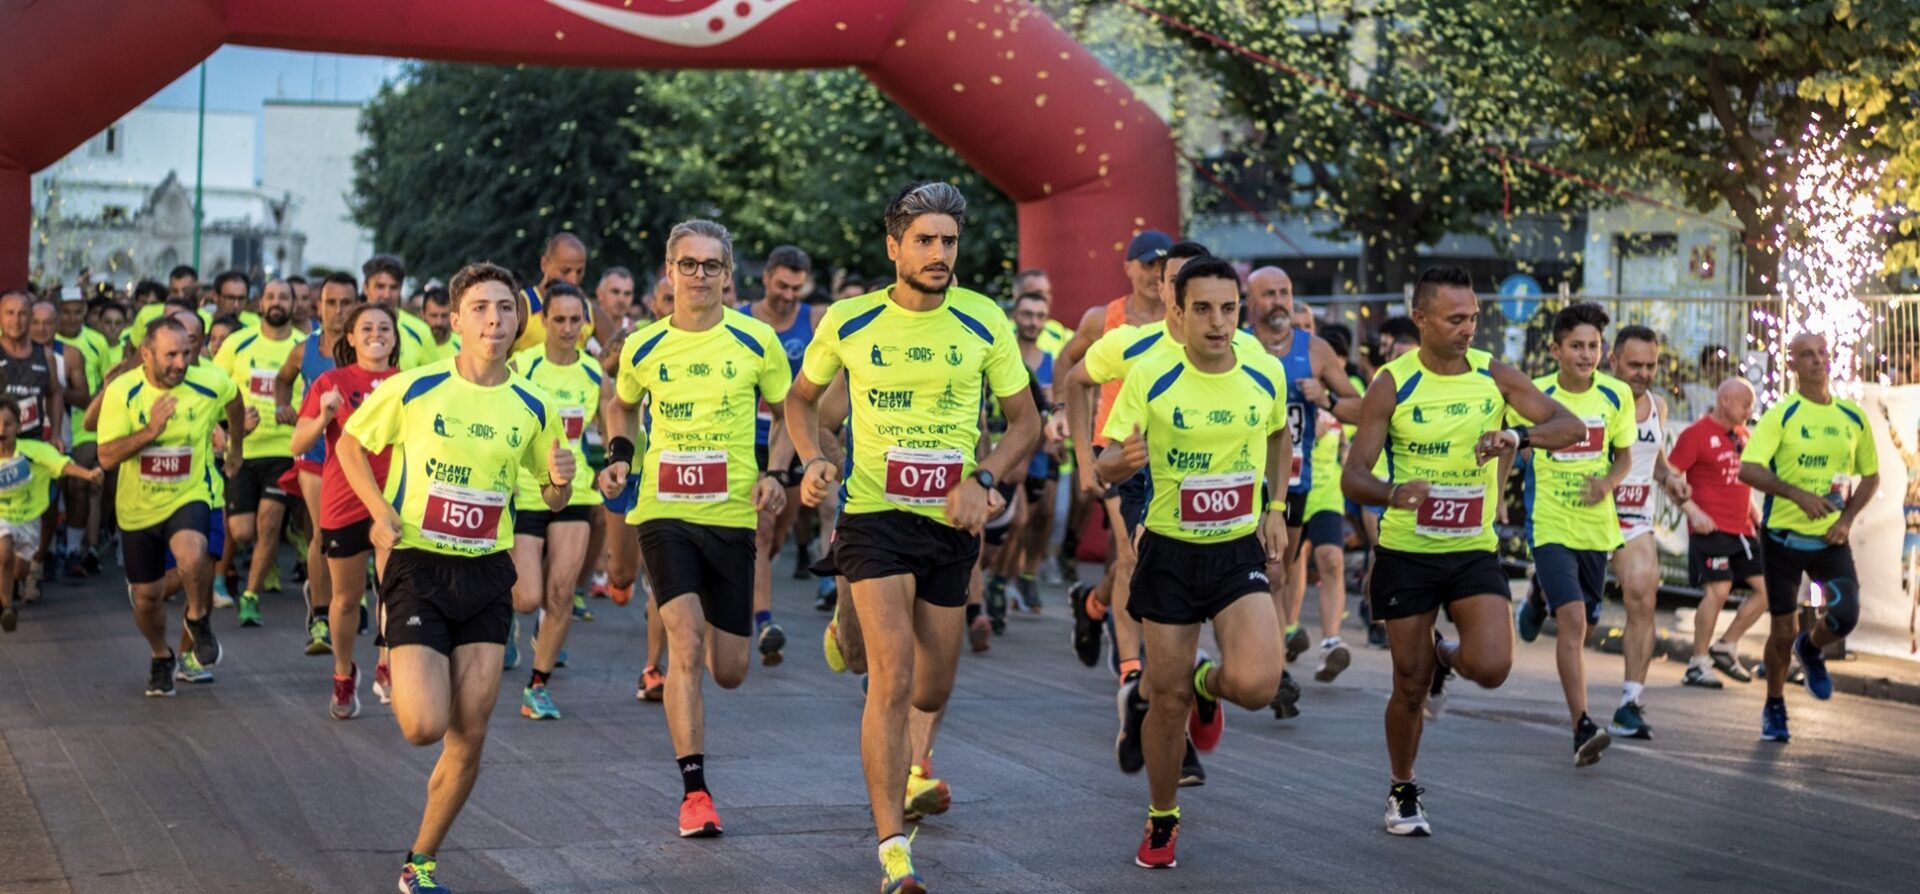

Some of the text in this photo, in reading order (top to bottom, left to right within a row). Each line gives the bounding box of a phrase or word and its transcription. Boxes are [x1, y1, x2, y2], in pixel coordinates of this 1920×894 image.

[908, 347, 933, 361] FIDAS
[879, 390, 914, 400] PLANET
[889, 399, 912, 408] GYM
[471, 423, 495, 439] FIDAS
[151, 456, 180, 473] 248
[1178, 451, 1214, 462] PLANET
[437, 462, 473, 477] PLANET
[1189, 460, 1210, 470] GYM
[447, 474, 470, 486] GYM
[675, 465, 705, 487] 161
[900, 465, 947, 492] 078
[1192, 489, 1240, 514] 080
[1616, 485, 1644, 503] 249
[441, 501, 485, 530] 150
[1431, 500, 1470, 524] 237
